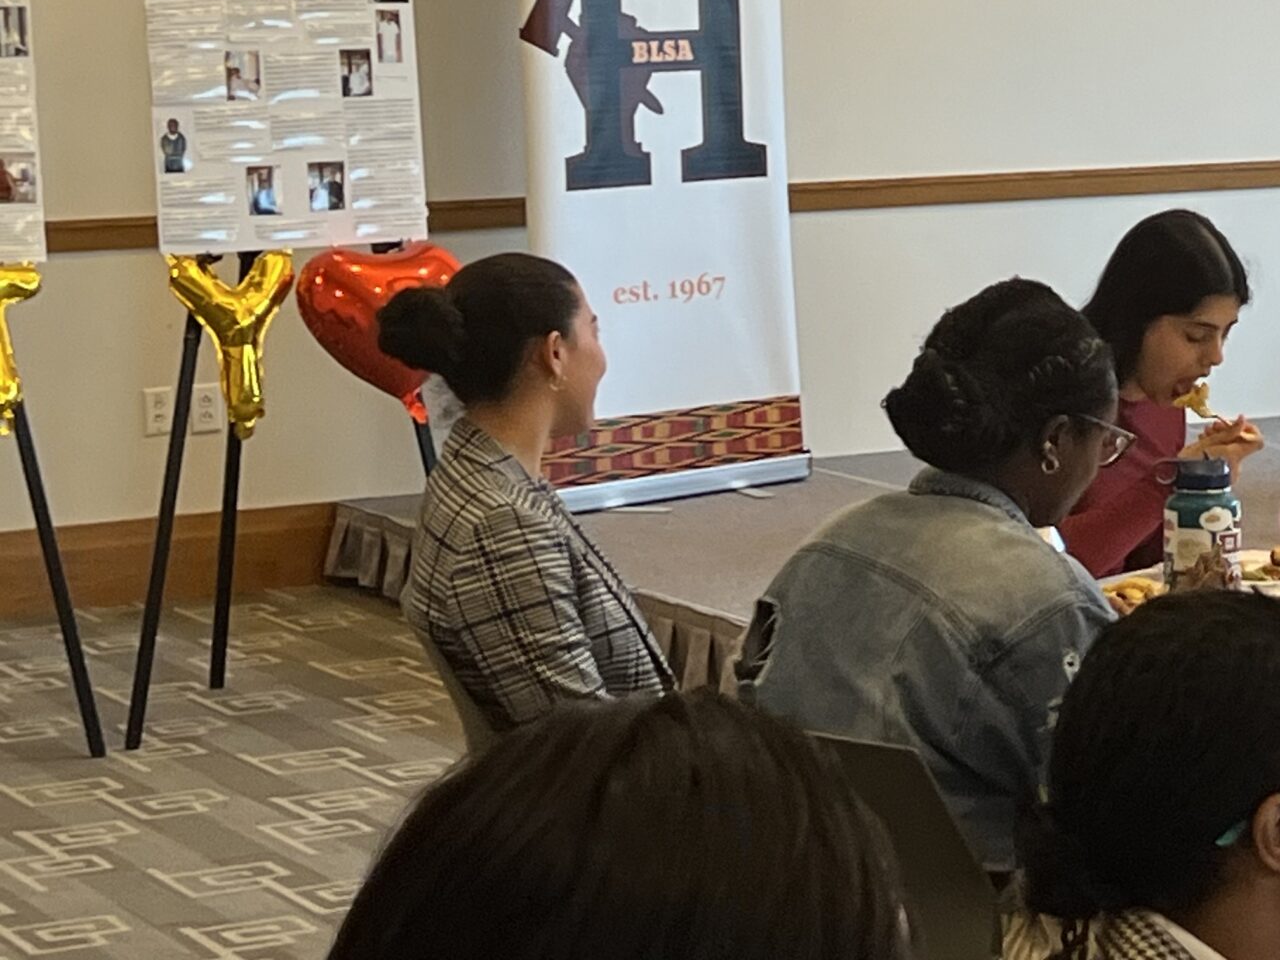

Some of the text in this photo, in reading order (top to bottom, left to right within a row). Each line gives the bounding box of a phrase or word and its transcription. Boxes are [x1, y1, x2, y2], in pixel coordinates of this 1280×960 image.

[631, 38, 694, 64] BLSA
[613, 272, 726, 304] est. 1967
